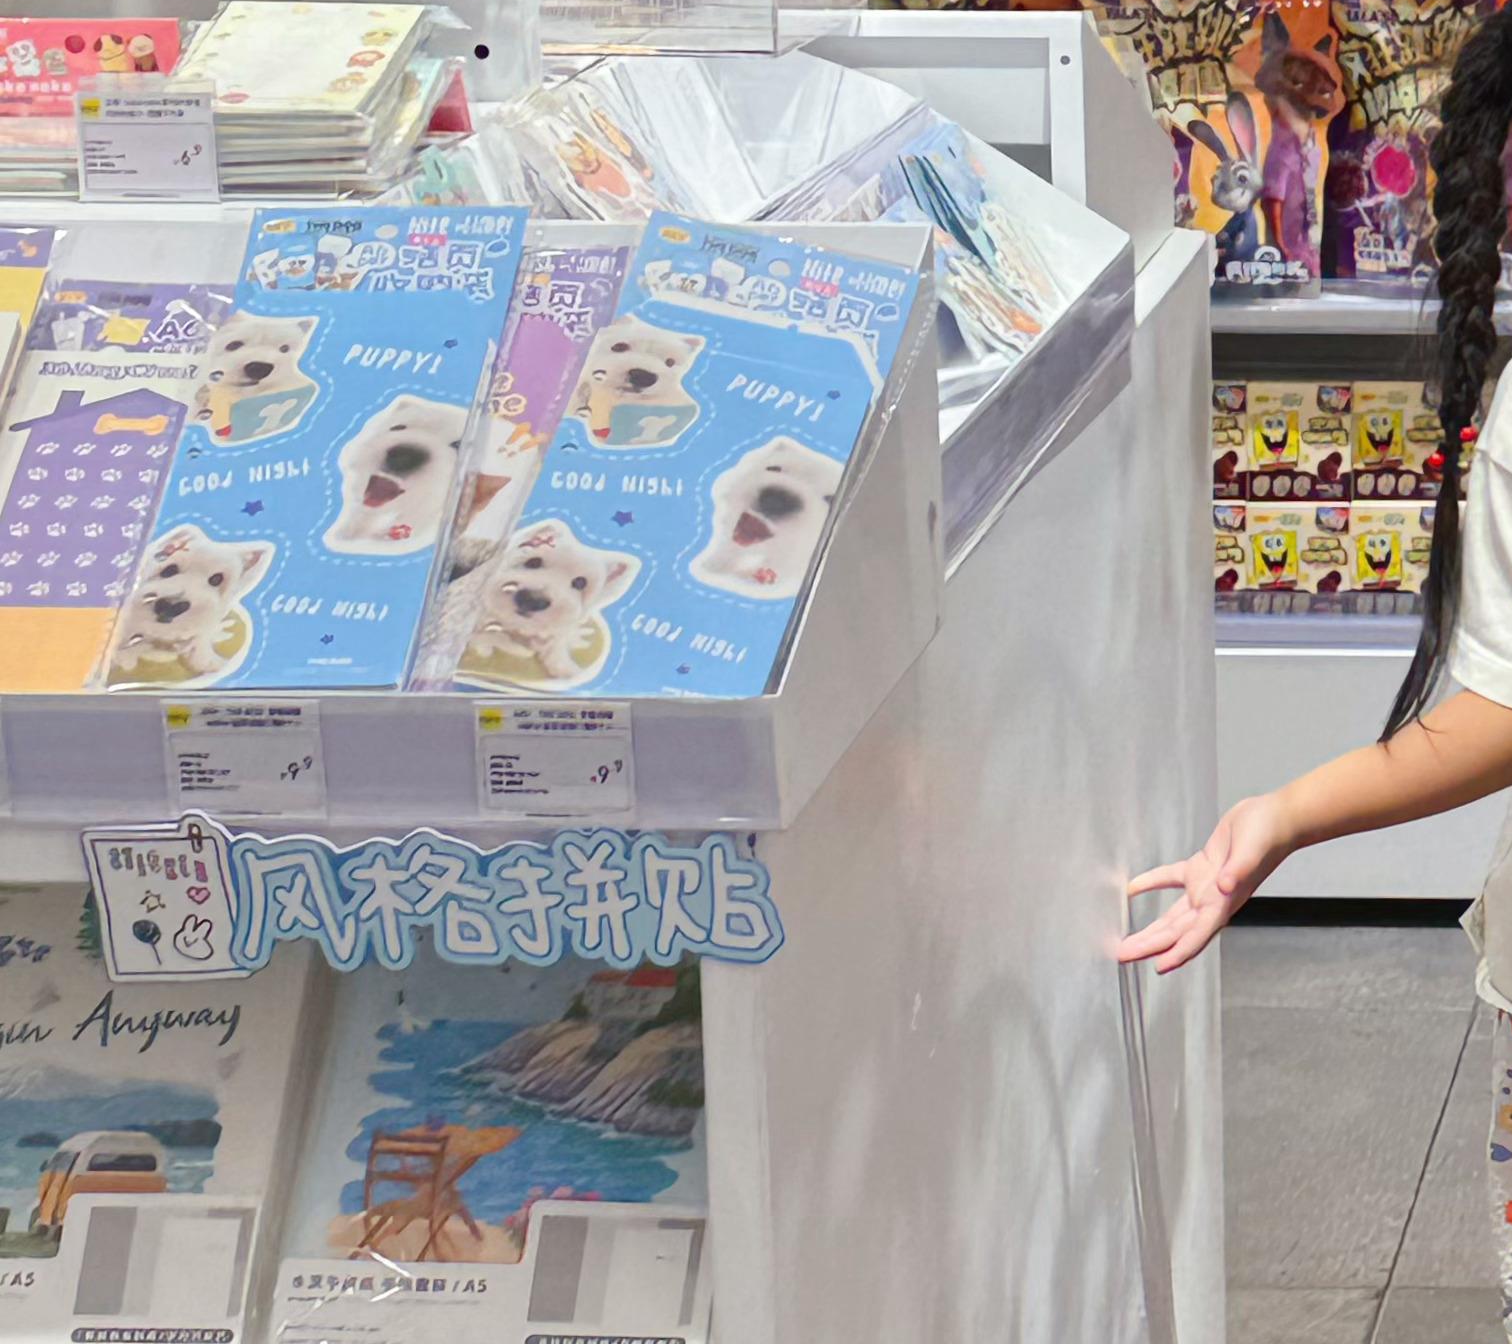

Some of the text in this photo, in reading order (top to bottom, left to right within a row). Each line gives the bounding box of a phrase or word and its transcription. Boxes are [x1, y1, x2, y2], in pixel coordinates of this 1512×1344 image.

[343, 343, 444, 375] PUPPY!
[726, 372, 826, 423] PUPPY!
[243, 836, 776, 962] 风格拼贴
[72, 990, 241, 1053] Anyway
